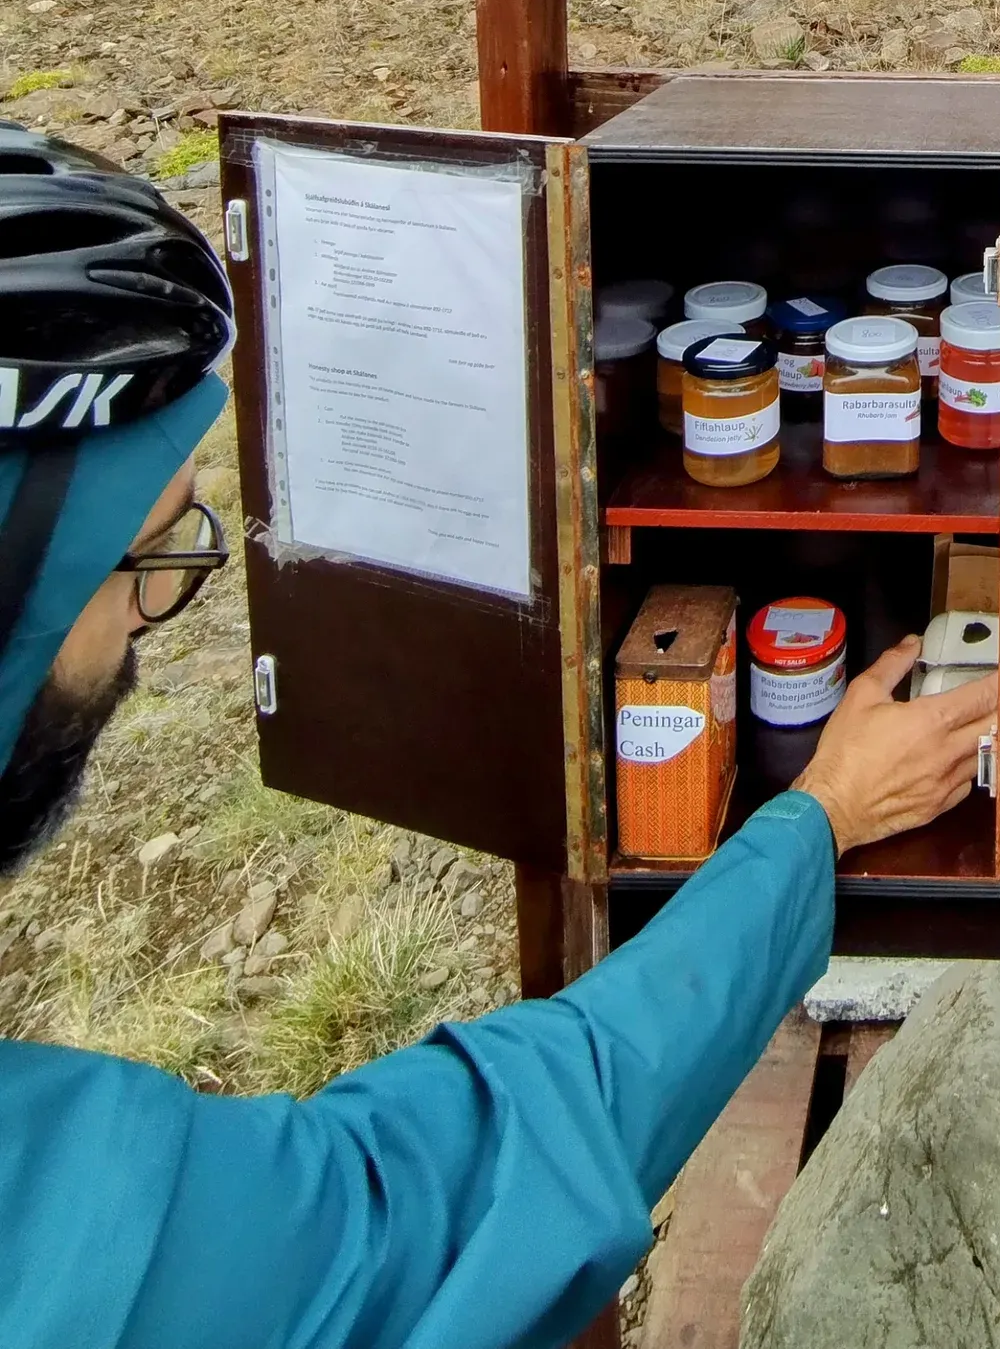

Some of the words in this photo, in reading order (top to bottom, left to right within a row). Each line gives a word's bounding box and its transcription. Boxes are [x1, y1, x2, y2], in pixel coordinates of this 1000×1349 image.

[861, 329, 882, 338] 800
[330, 367, 346, 375] shop
[842, 400, 917, 410] Rabarbarasulta
[695, 433, 727, 443] Dandelion
[812, 676, 824, 685] og
[620, 710, 703, 732] Peningar
[620, 740, 665, 757] Cash
